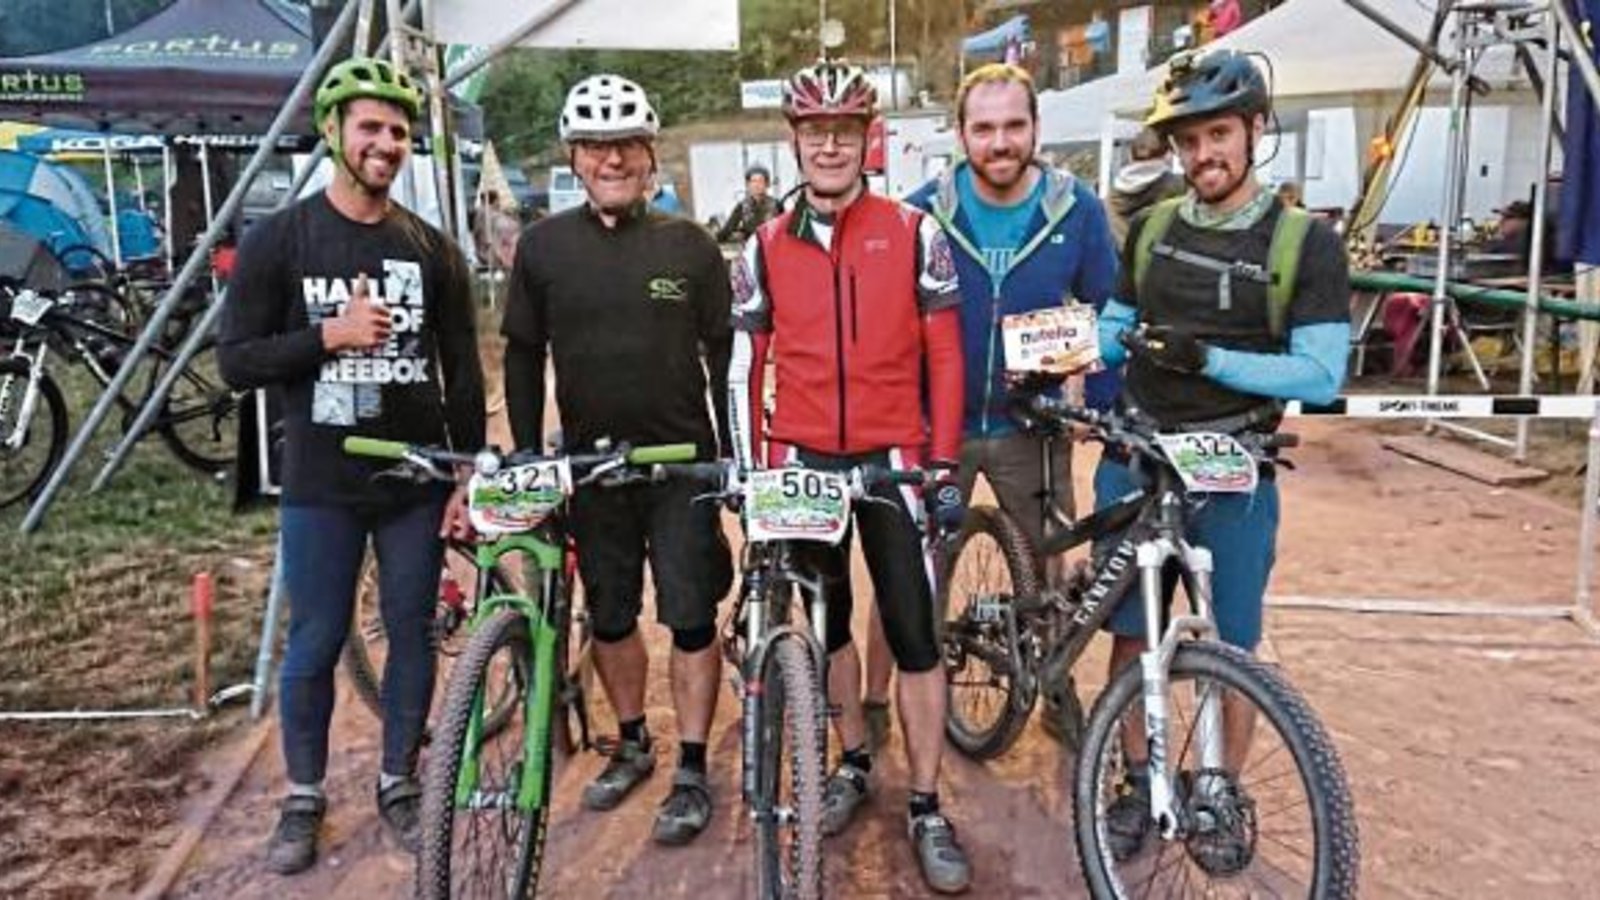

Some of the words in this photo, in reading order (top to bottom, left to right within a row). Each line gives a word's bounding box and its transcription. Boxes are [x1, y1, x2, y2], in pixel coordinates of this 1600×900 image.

[52, 135, 165, 149] KOGA
[320, 358, 428, 384] REEBOK
[501, 464, 560, 495] 321
[782, 472, 843, 500] 505
[1073, 539, 1135, 626] CANYON
